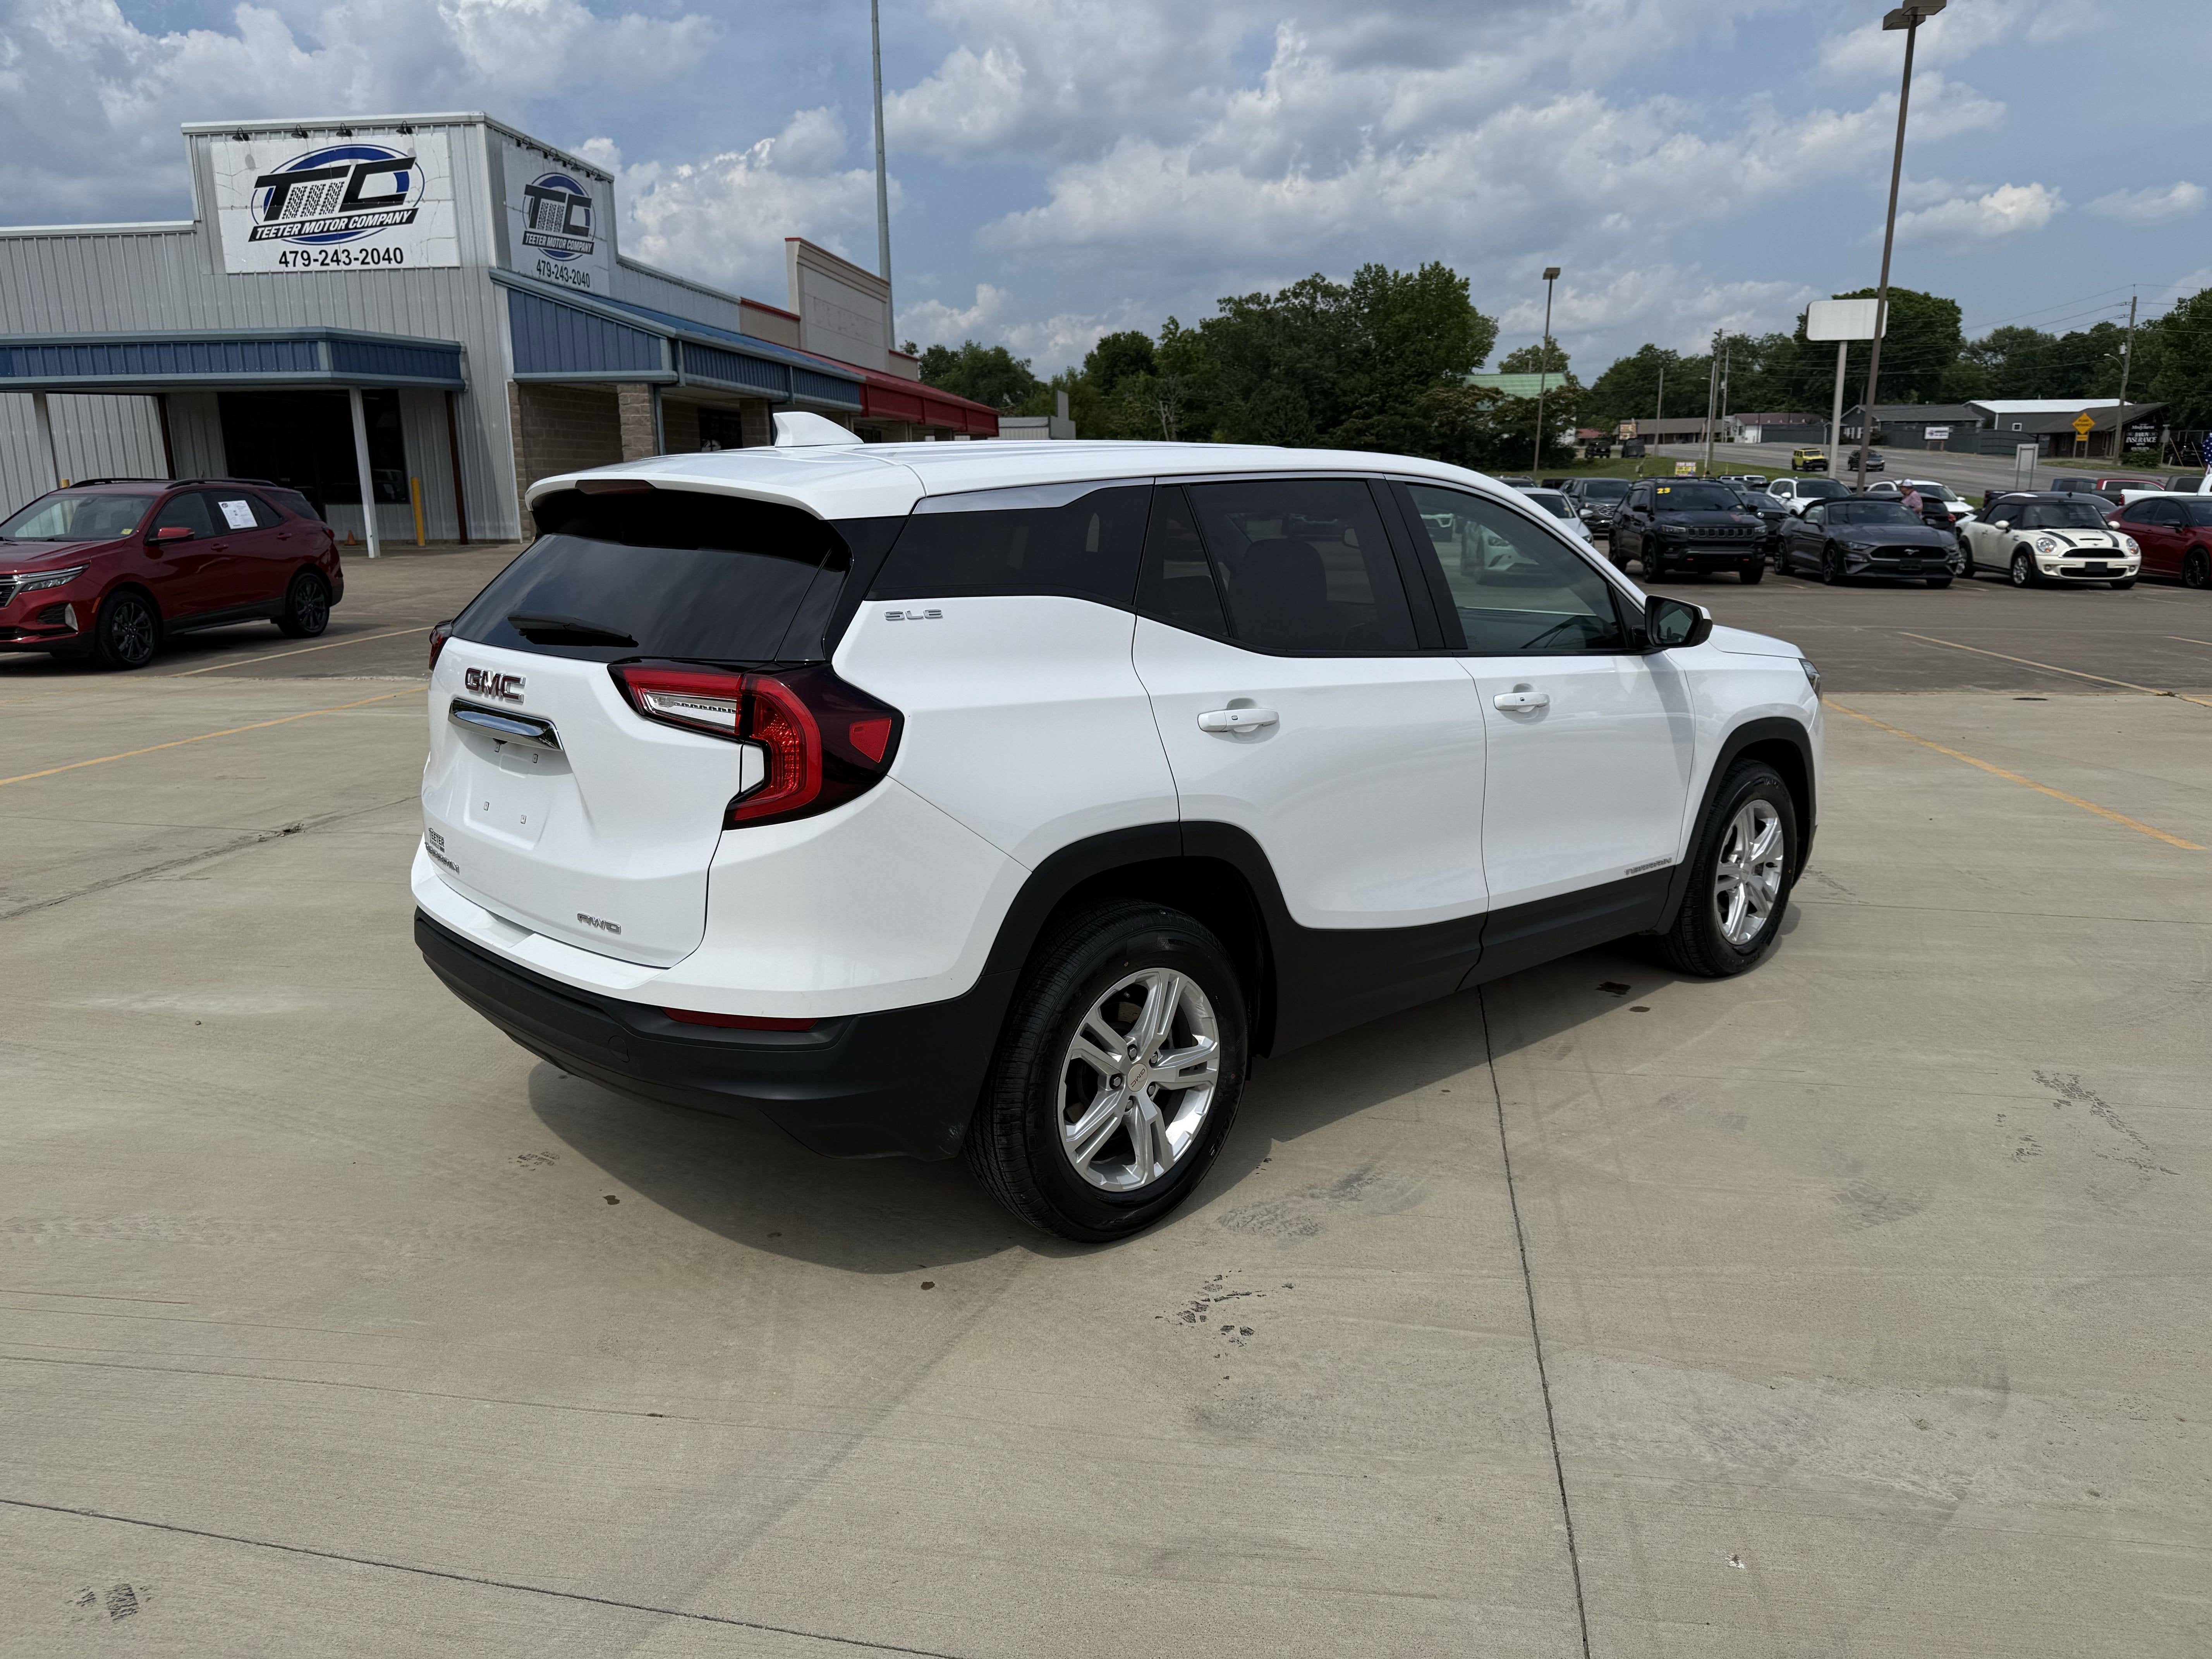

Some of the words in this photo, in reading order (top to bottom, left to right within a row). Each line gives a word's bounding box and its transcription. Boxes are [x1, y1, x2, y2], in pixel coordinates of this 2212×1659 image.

[255, 225, 299, 239] TEETER
[301, 218, 347, 234] MOTOR
[349, 210, 413, 229] COMPANY
[526, 234, 546, 244] TEETER
[546, 237, 566, 247] MOTOR
[567, 239, 592, 252] COMPANY
[279, 247, 404, 268] 479-243-2040
[537, 259, 590, 288] 479-243-2040
[884, 609, 943, 621] SLE
[465, 668, 526, 704] GMC
[429, 828, 445, 847] TEETER
[577, 913, 621, 935] AWD
[1131, 1068, 1146, 1087] GMC
